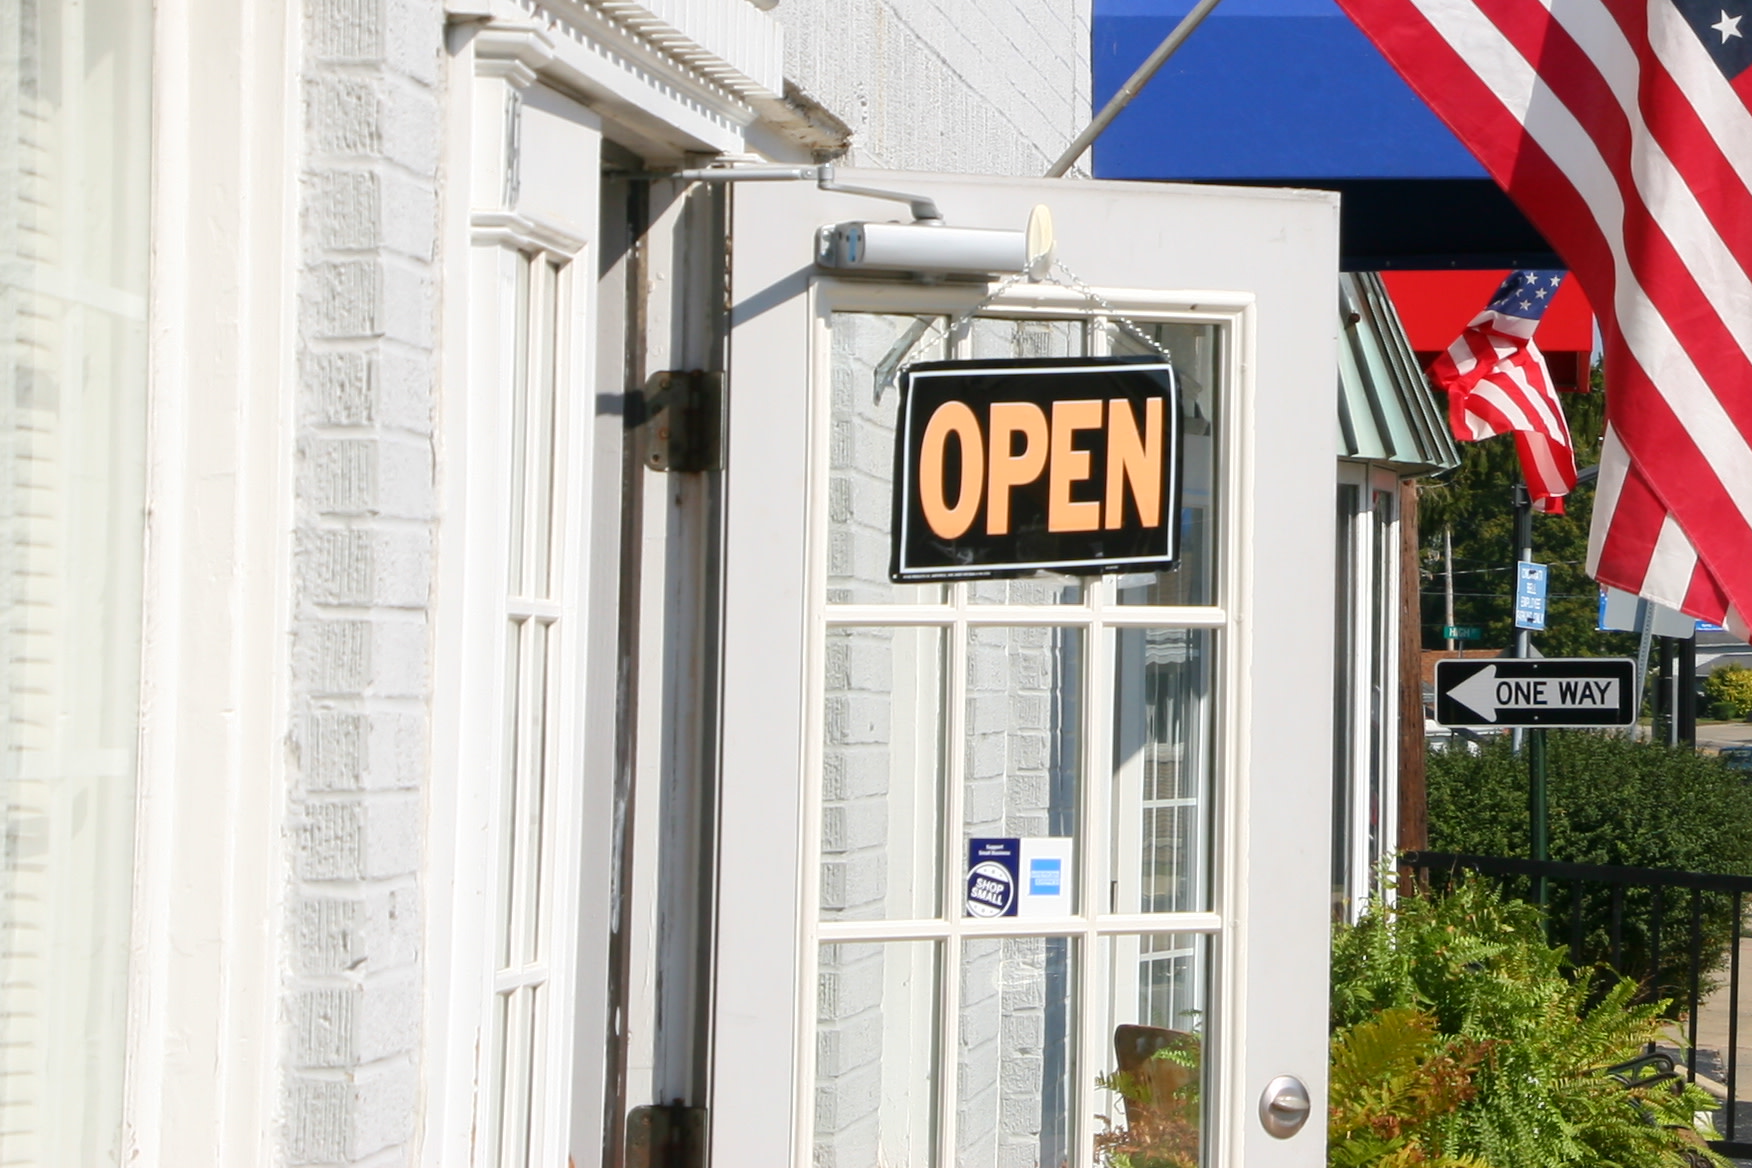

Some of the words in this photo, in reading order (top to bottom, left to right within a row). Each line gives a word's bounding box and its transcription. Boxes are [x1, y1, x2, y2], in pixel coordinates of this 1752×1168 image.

[919, 397, 1163, 540] OPEN
[1496, 681, 1547, 705] ONE
[1559, 681, 1612, 705] WAY
[971, 887, 1002, 905] SMALL
[976, 878, 1004, 893] SHOP
